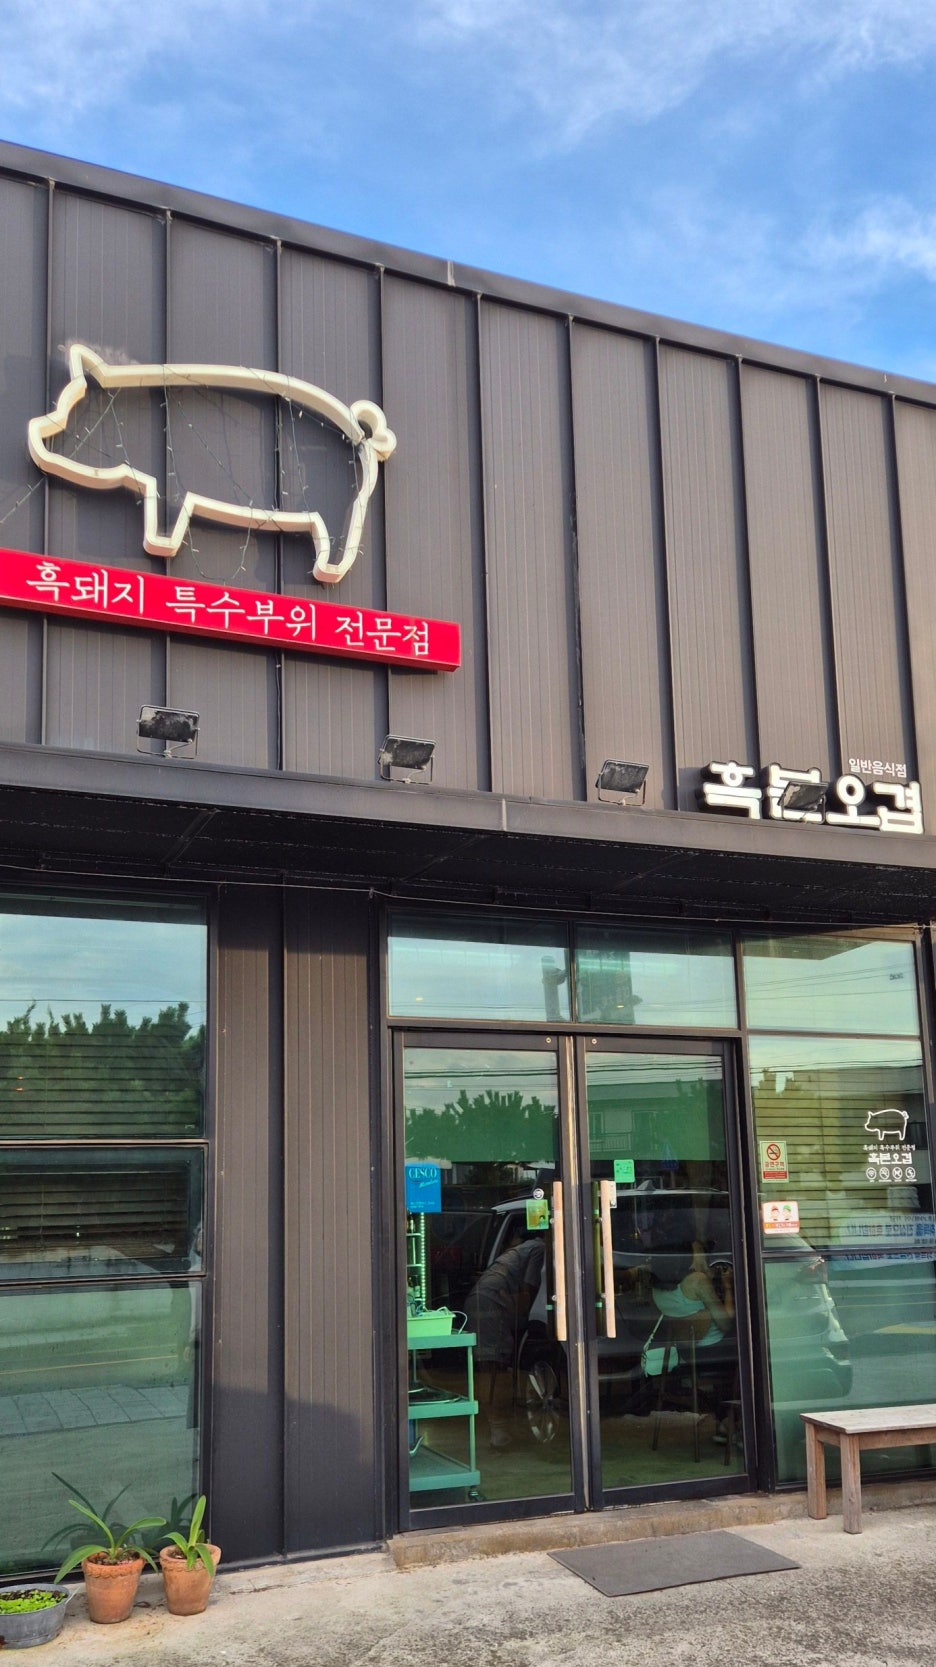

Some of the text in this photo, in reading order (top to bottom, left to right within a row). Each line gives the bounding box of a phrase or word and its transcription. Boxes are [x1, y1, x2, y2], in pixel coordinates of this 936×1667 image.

[26, 561, 430, 656] 흑돼지 특수부위 전문점
[849, 758, 907, 777] 일반음식점
[408, 1167, 437, 1179] CESCO
